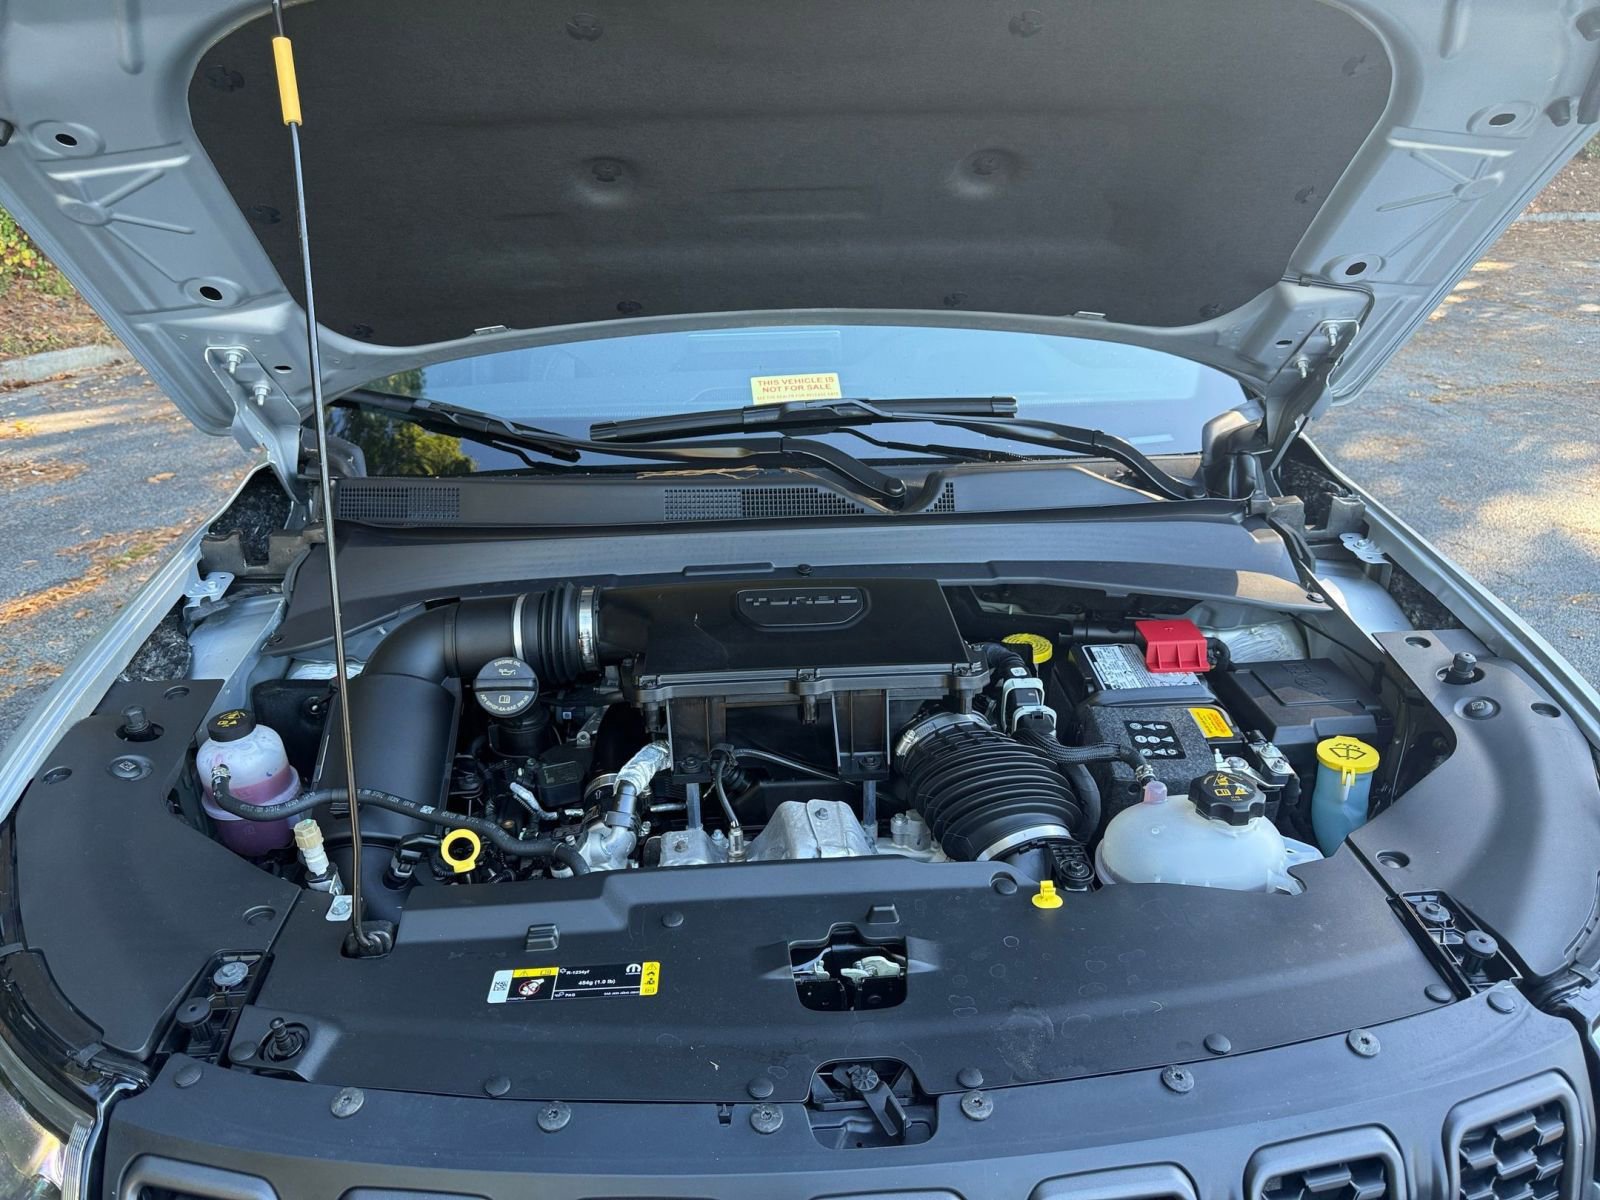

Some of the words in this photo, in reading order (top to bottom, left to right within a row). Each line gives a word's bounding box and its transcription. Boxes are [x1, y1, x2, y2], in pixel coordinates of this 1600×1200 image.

[781, 377, 822, 385] VEHICLE
[806, 383, 832, 391] SALE
[494, 659, 513, 667] ENGINE
[513, 660, 521, 668] OIL
